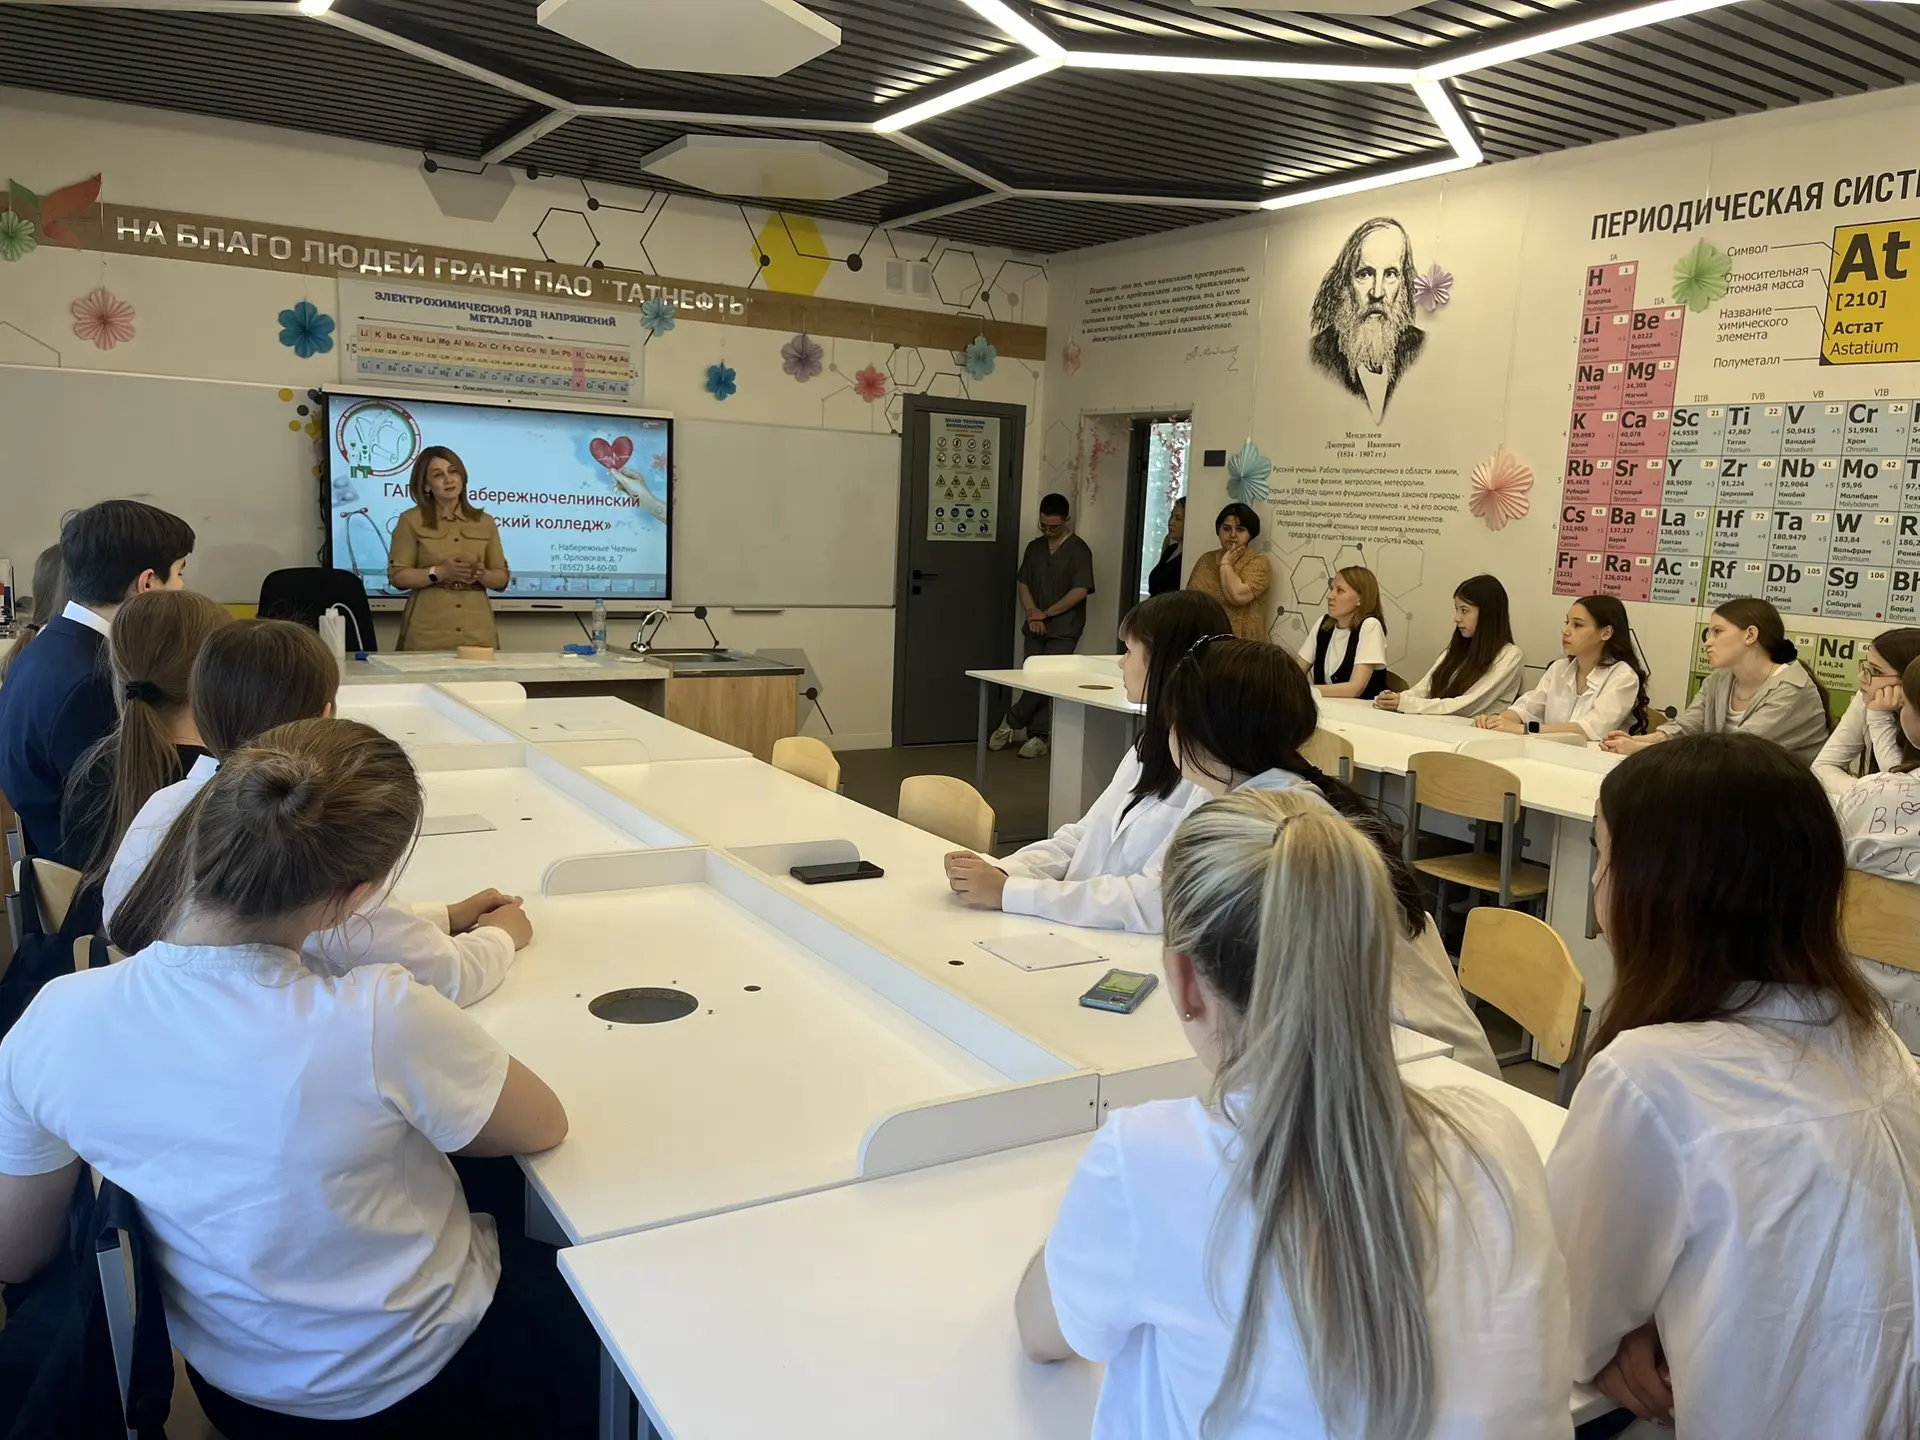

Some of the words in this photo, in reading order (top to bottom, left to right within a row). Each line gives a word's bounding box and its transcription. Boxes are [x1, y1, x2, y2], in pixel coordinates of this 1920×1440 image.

[1591, 181, 1824, 240] ПЕРИОДИЧЕСКАЯ
[1833, 168, 1920, 208] СИСТ
[116, 216, 168, 246] НА
[176, 222, 292, 260] БЛАГО
[301, 239, 425, 277] ЛЮДЕЙ
[433, 256, 528, 289] ГРАНТ
[534, 270, 593, 298] ПАО
[1727, 244, 1768, 257] Символ
[1834, 231, 1911, 284] At
[1588, 269, 1603, 287] H
[1724, 266, 1809, 283] Относительная
[1772, 278, 1805, 290] масса
[374, 291, 512, 315] ЭЛЕКТРОХИМИЧЕСКИЙ
[515, 307, 537, 319] РЯД
[540, 311, 616, 327] НАПРЯЖЕНИЙ
[1836, 290, 1887, 311] [210]
[469, 313, 532, 328] МЕТАЛЛОВ
[1719, 306, 1772, 319] Название
[1584, 316, 1600, 335] Li
[1633, 313, 1660, 331] Be
[1718, 317, 1788, 331] химического
[1833, 321, 1884, 335] Астат
[1716, 330, 1768, 343] элемента
[1830, 341, 1899, 356] Astatium
[1627, 362, 1656, 381] Mg
[1713, 356, 1780, 369] Полуметалл
[1578, 365, 1604, 383] Na
[1813, 390, 1824, 398] VB
[1874, 388, 1889, 396] VIB
[1573, 413, 1587, 430] K
[1621, 411, 1647, 429] Ca
[1672, 408, 1700, 427] Sc
[1729, 406, 1750, 426] Ti
[1788, 405, 1805, 425] V
[1848, 403, 1878, 424] Cr
[1846, 438, 1866, 446] Хром
[1568, 459, 1594, 477] Rb
[1615, 459, 1638, 477] Sr
[1668, 459, 1683, 477] Y
[1721, 459, 1748, 477] Zr
[1781, 458, 1815, 478] Nb
[1842, 458, 1879, 479] Mo
[468, 486, 640, 508] абережночелнинский
[1429, 492, 1461, 500] природы
[1840, 492, 1878, 500] Молибден
[536, 516, 612, 531] колледж»
[1563, 506, 1585, 523] Cs
[1611, 507, 1636, 525] Ba
[1661, 508, 1686, 527] La
[1716, 509, 1744, 528] Hf
[1774, 511, 1803, 531] Ta
[1836, 513, 1862, 533] W
[1772, 543, 1797, 551] Тантал
[1833, 546, 1872, 555] Вольфрам
[1558, 552, 1578, 568] Fr
[1605, 555, 1631, 573] Ra
[1654, 557, 1682, 576] Ac
[1709, 560, 1738, 579] Rf
[1767, 563, 1801, 584] Db
[1827, 567, 1859, 589] Sg
[1766, 585, 1786, 594] [262]
[1827, 589, 1848, 598] [263]
[1891, 594, 1913, 603] [267]
[1826, 600, 1861, 609] Сиборгий
[1890, 605, 1914, 613] Борий
[1819, 638, 1855, 660] Nd
[1818, 661, 1843, 669] 144,24
[1817, 672, 1845, 680] Неодим
